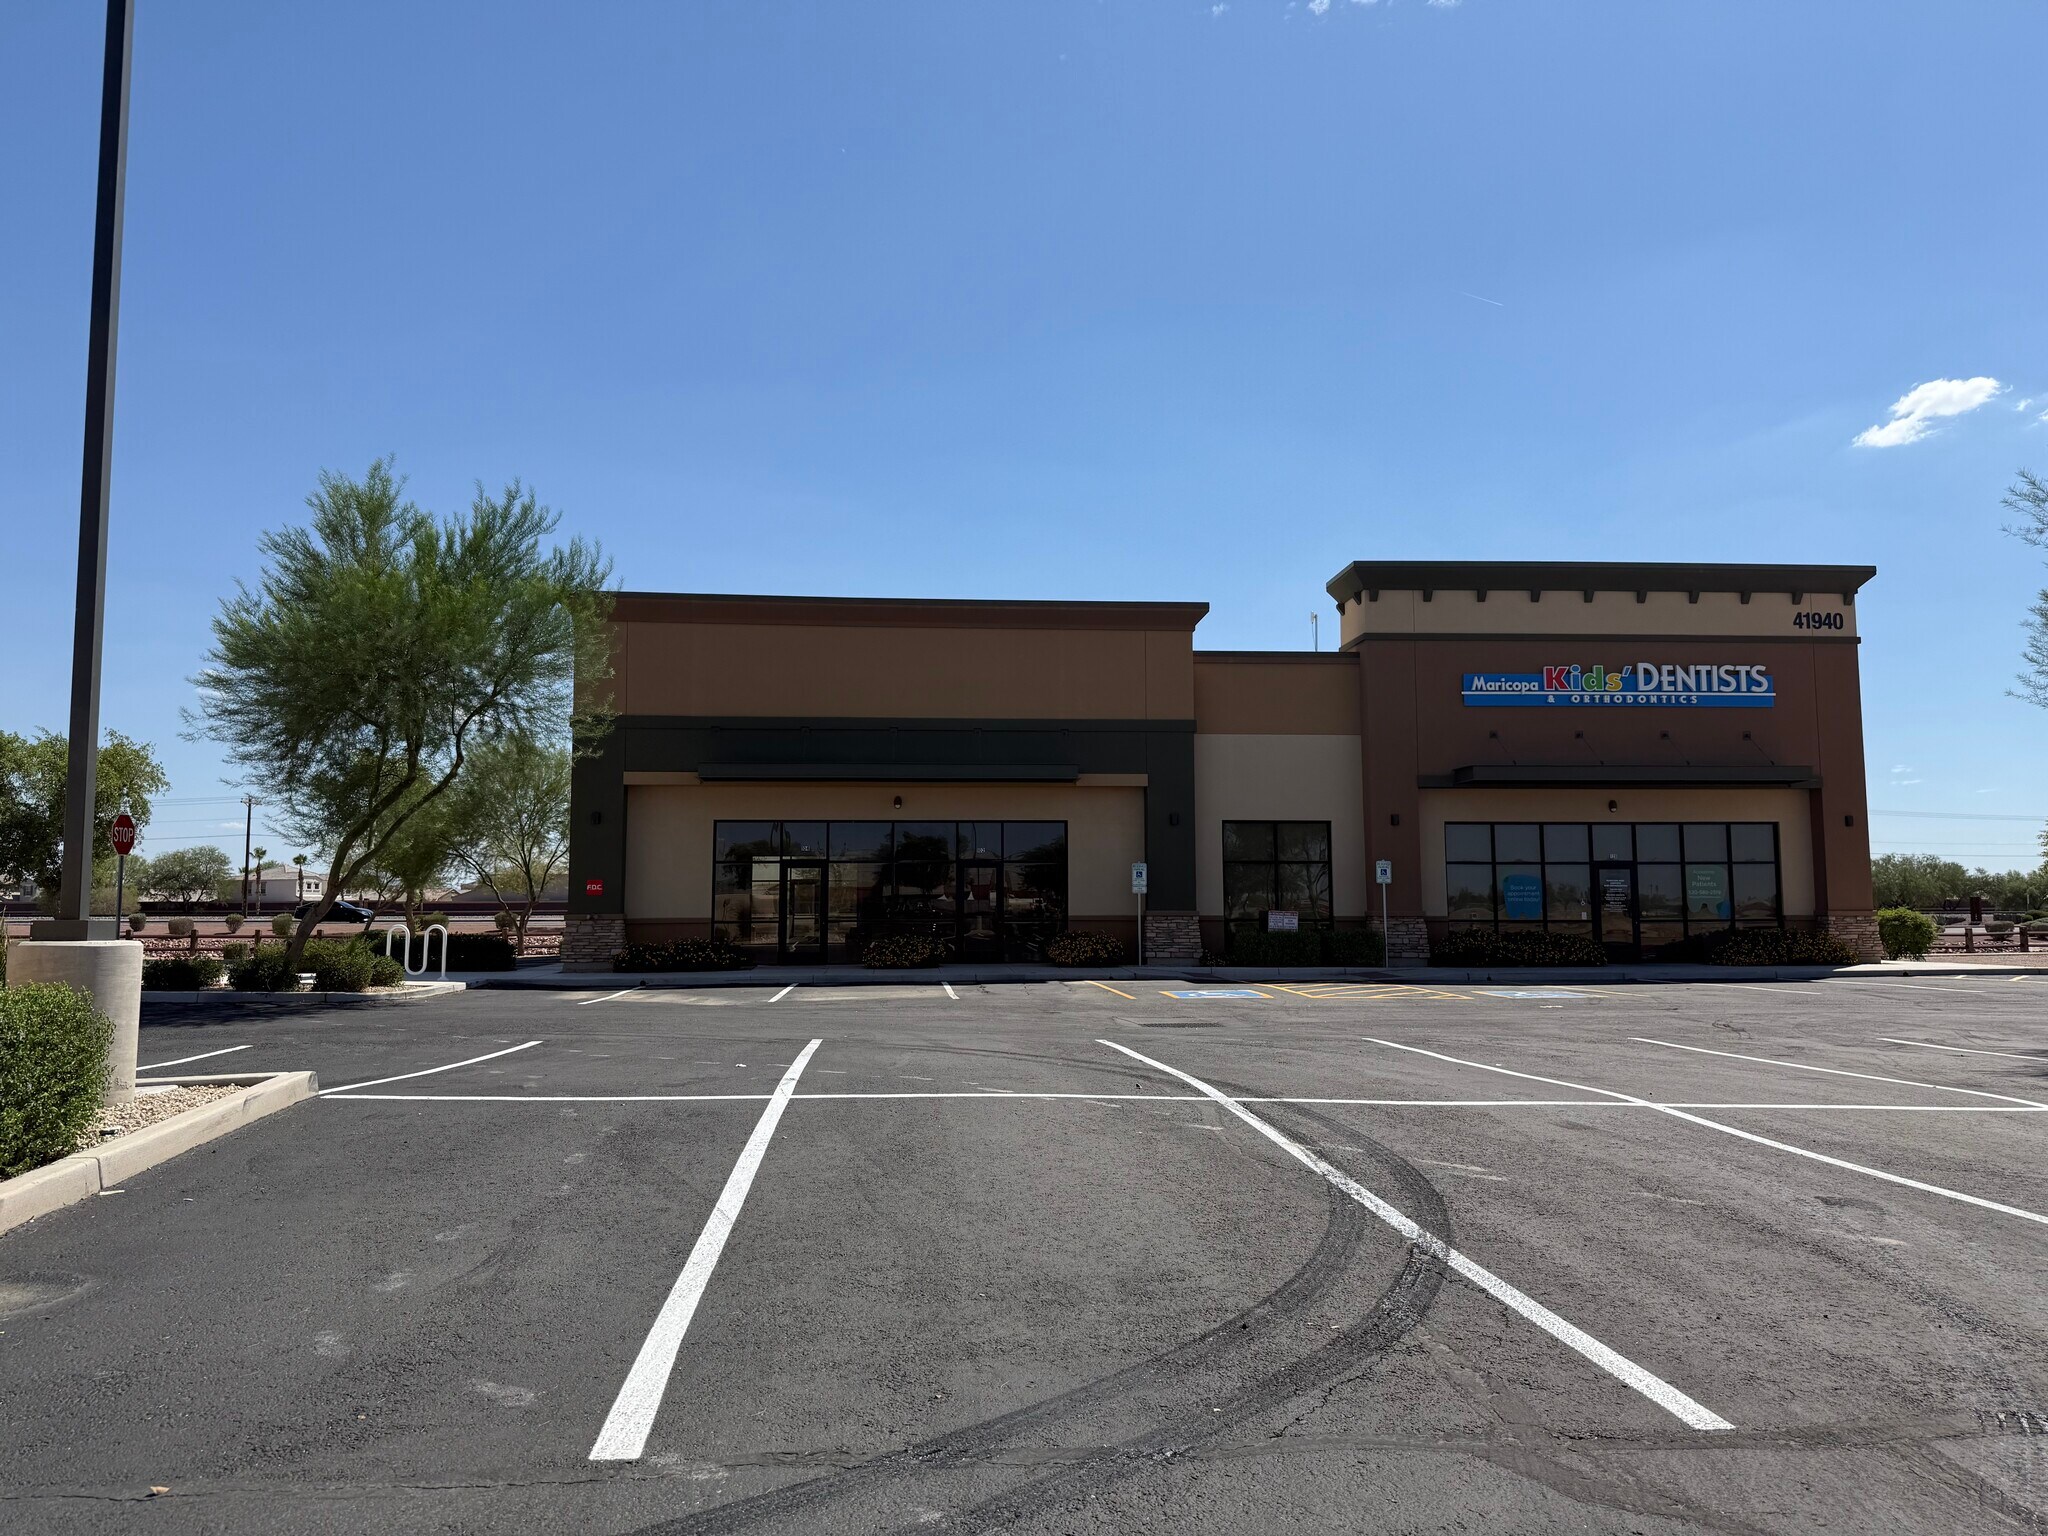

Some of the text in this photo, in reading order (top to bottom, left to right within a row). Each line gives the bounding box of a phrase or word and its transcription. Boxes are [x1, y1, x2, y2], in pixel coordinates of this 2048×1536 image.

[1793, 612, 1844, 630] 41940
[1471, 662, 1769, 693] Maricopa Kids' DENTISTS
[1547, 695, 1698, 704] & ORTHODONTICS
[113, 827, 134, 843] STOP
